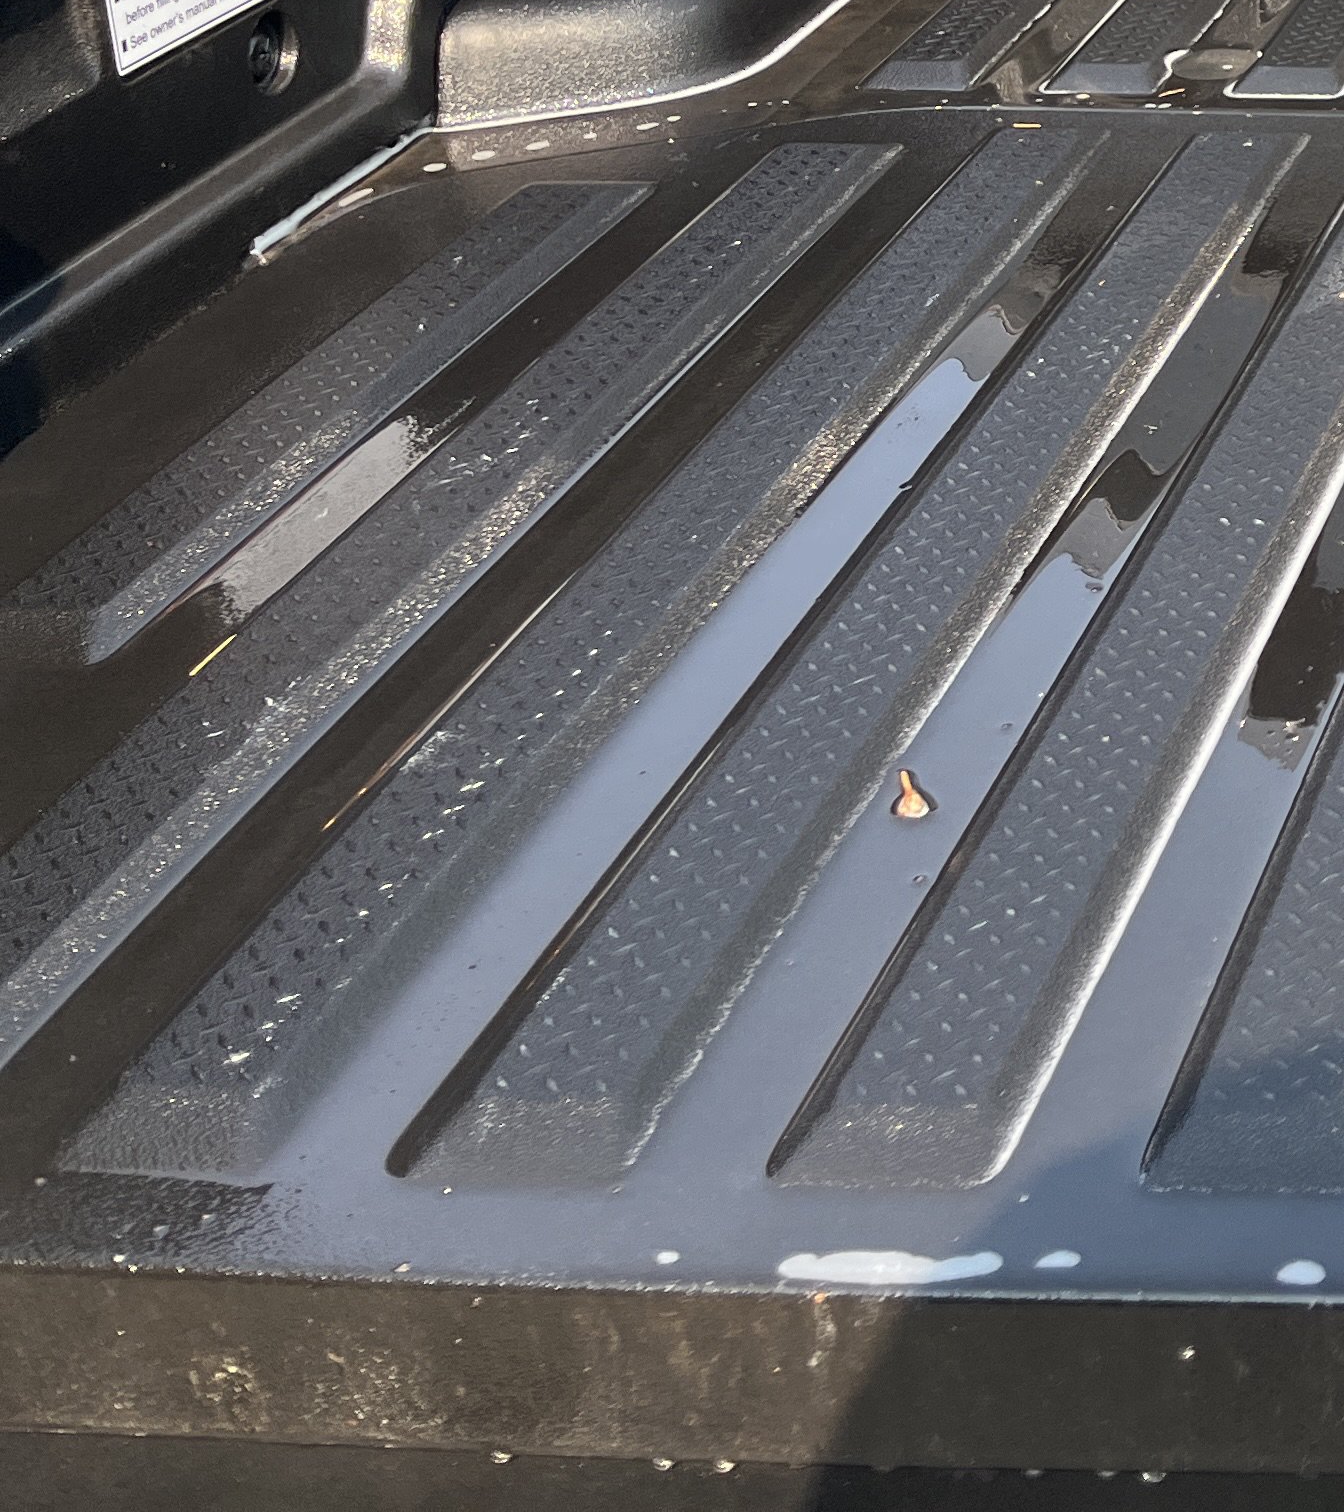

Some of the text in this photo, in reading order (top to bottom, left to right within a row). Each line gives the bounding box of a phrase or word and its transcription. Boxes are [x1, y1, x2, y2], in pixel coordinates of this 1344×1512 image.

[125, 1, 155, 25] before
[130, 32, 148, 49] See
[150, 10, 184, 36] owner's
